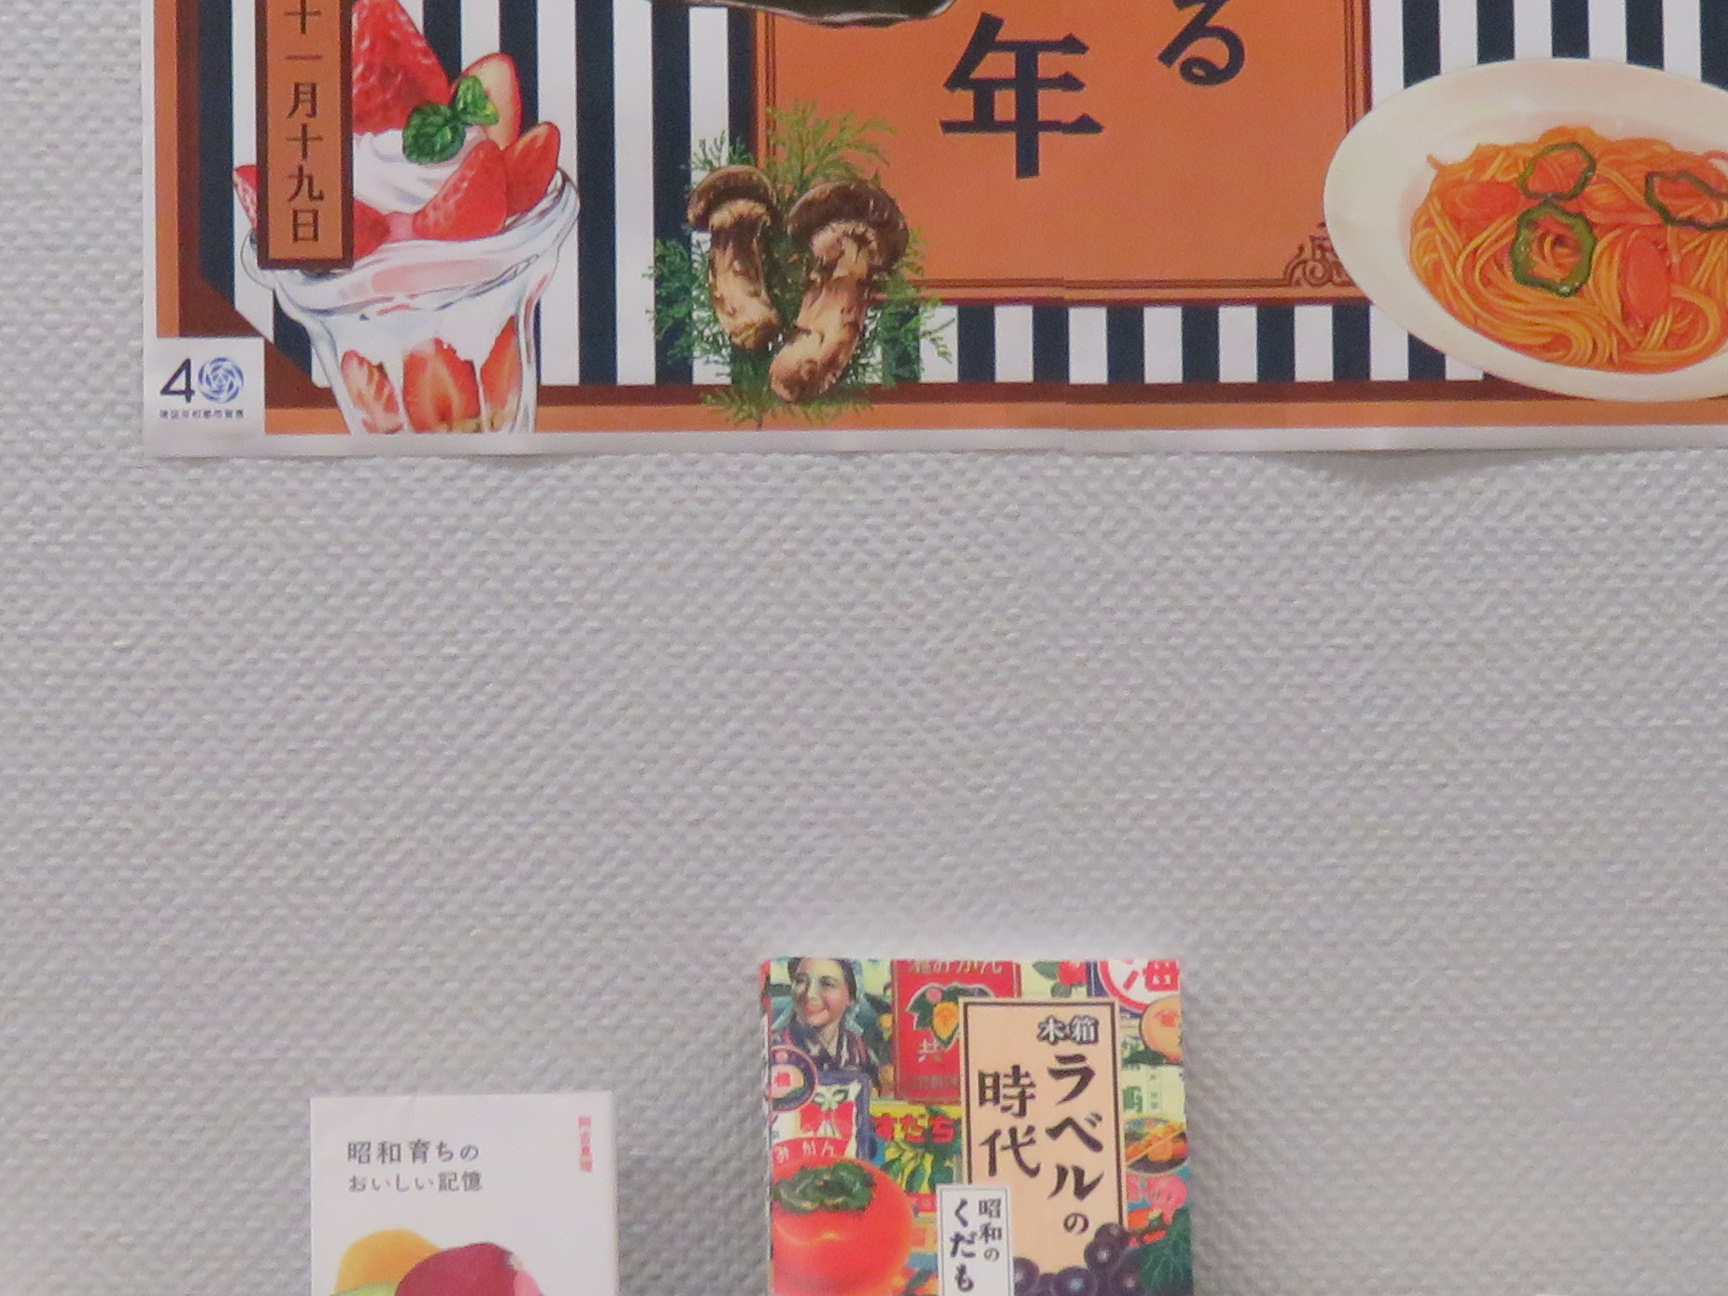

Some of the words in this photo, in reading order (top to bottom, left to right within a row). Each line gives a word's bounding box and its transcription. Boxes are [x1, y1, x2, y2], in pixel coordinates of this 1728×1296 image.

[1037, 1014, 1100, 1045] 木箱
[977, 1064, 1042, 1180] 時代
[1045, 1052, 1105, 1236] ラベルの
[347, 1139, 479, 1166] 昭和育ちの
[348, 1169, 483, 1194] おいしい記憶
[978, 1197, 1003, 1264] 昭和の
